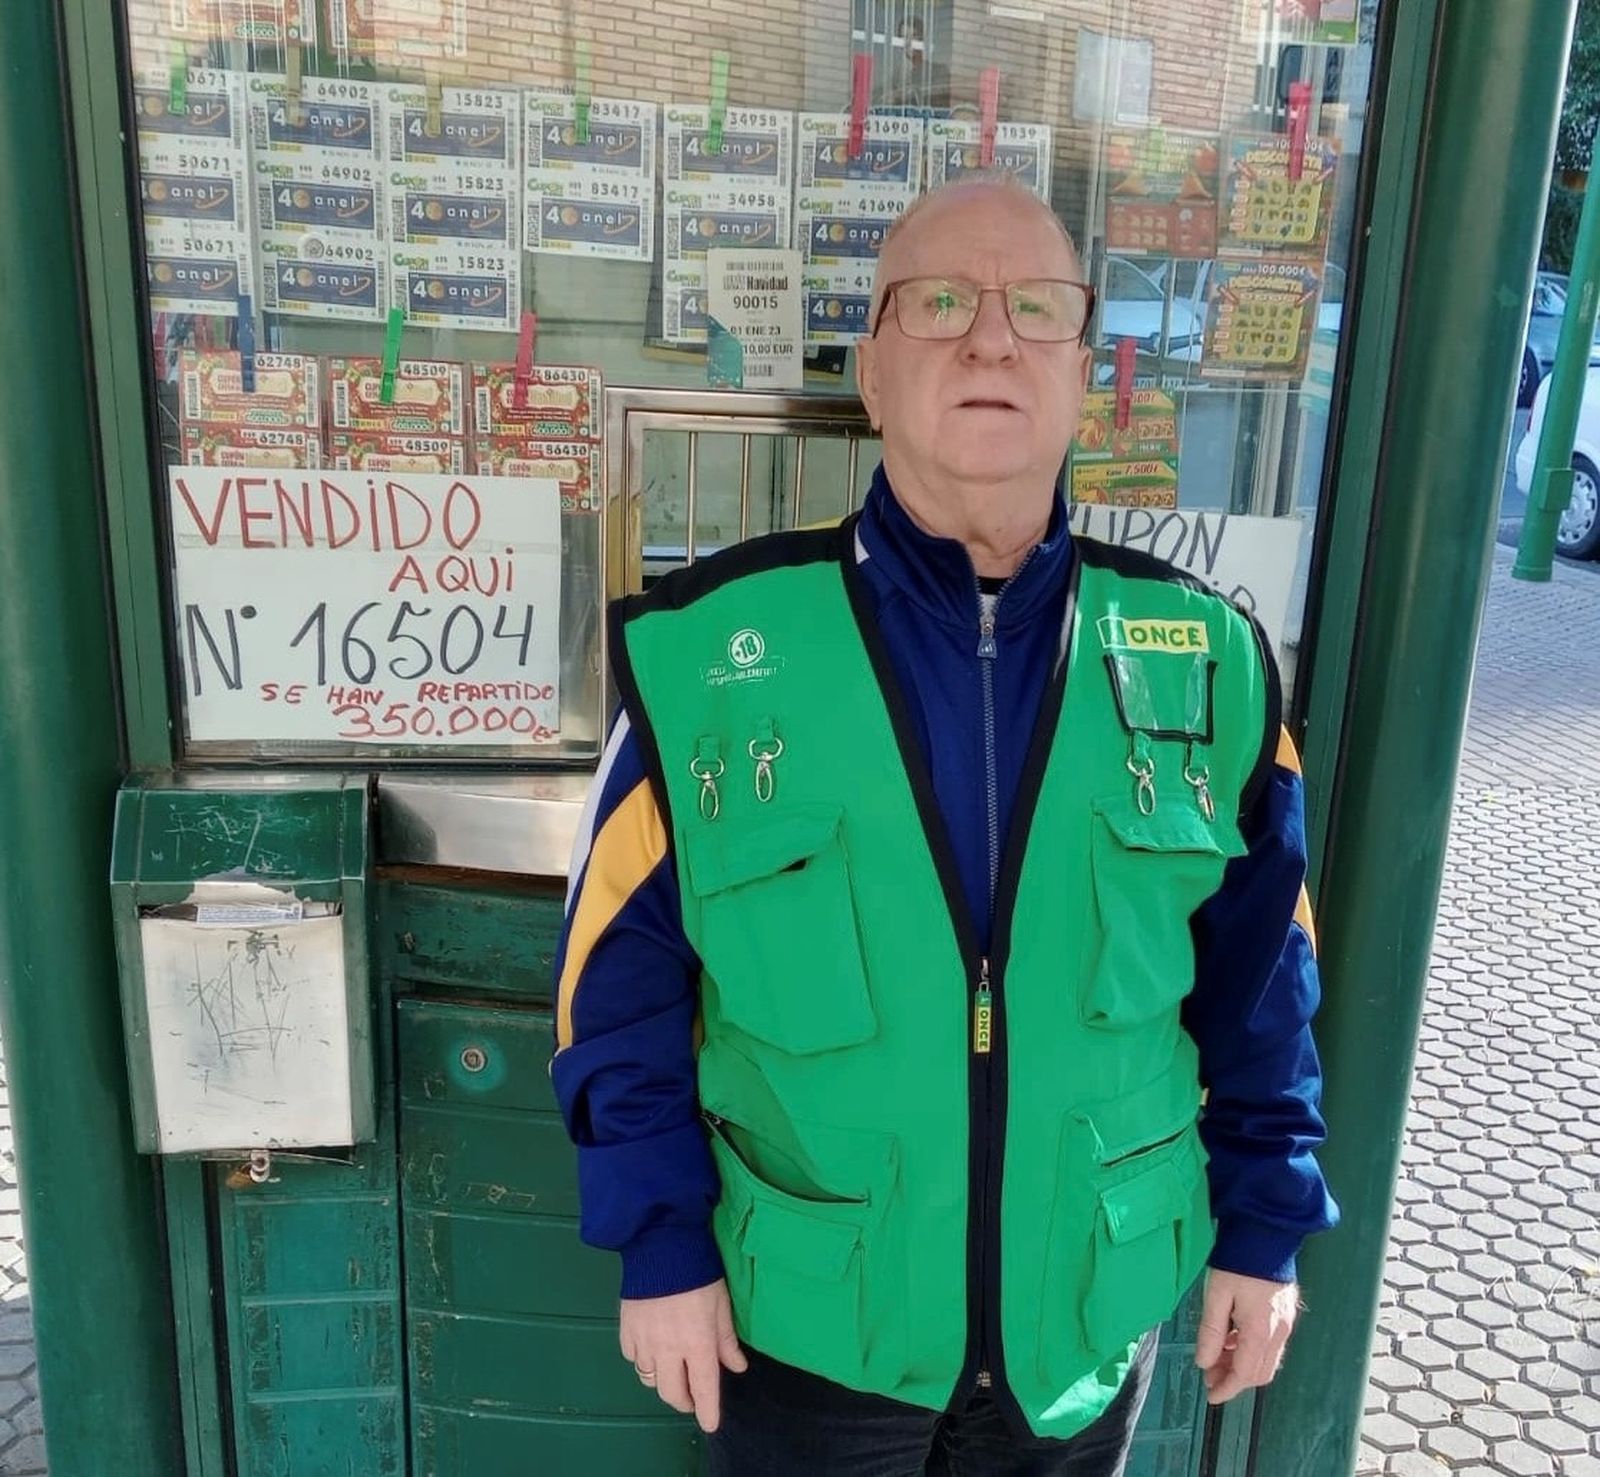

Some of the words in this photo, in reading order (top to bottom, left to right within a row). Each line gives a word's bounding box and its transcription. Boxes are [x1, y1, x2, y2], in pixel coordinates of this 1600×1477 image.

[186, 72, 227, 86] 0671
[317, 83, 369, 99] 64902
[456, 92, 504, 109] 15823
[592, 103, 640, 118] 83417
[729, 111, 777, 126] 34958
[179, 155, 230, 171] 50671
[322, 165, 372, 182] 64902
[457, 175, 504, 191] 15823
[591, 183, 638, 198] 83417
[728, 193, 775, 207] 34958
[858, 199, 905, 213] 41690
[183, 238, 234, 253] 50671
[325, 244, 374, 262] 64902
[458, 256, 505, 271] 15823
[854, 276, 871, 289] 41
[733, 295, 778, 309] 90015
[773, 344, 793, 354] EUR
[257, 356, 301, 368] 62748
[403, 364, 447, 376] 48509
[543, 369, 586, 381] 86430
[259, 433, 304, 445] 62748
[405, 441, 448, 452] 48509
[545, 444, 587, 455] 86430
[1069, 504, 1228, 575] UPON
[290, 601, 534, 686] 16504
[1129, 626, 1202, 647] ONCE
[259, 682, 308, 704] SE
[327, 687, 385, 705] HAN
[418, 680, 556, 704] REPARTIDO
[979, 1009, 989, 1050] ONCE
